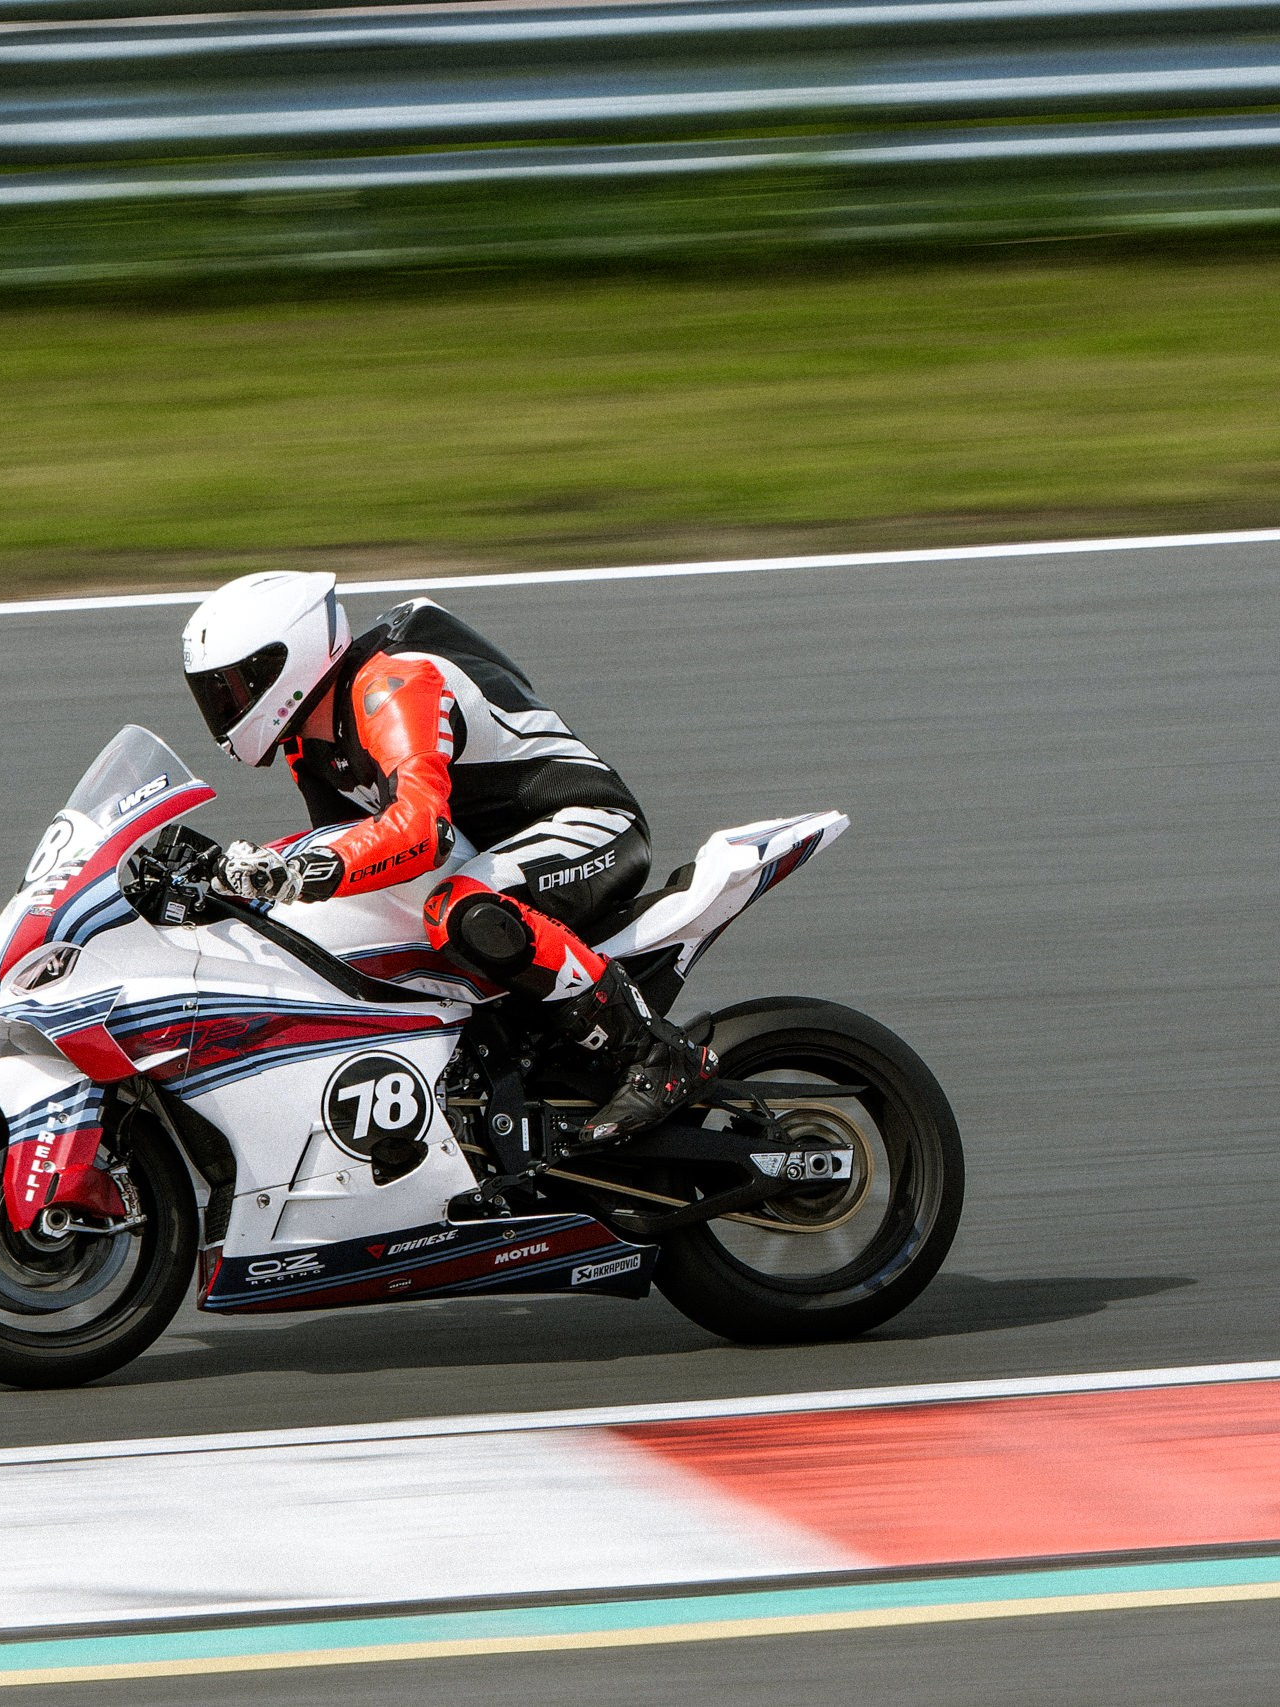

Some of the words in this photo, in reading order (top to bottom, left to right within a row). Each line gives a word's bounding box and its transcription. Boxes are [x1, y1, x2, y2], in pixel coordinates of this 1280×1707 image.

[120, 774, 168, 813] WRS
[350, 838, 430, 883] DAINESE
[538, 850, 616, 892] DAINESE
[337, 1072, 419, 1140] 78
[24, 1101, 64, 1202] PIRELLI
[387, 1229, 458, 1256] DAINESE
[494, 1241, 550, 1265] MOTUL
